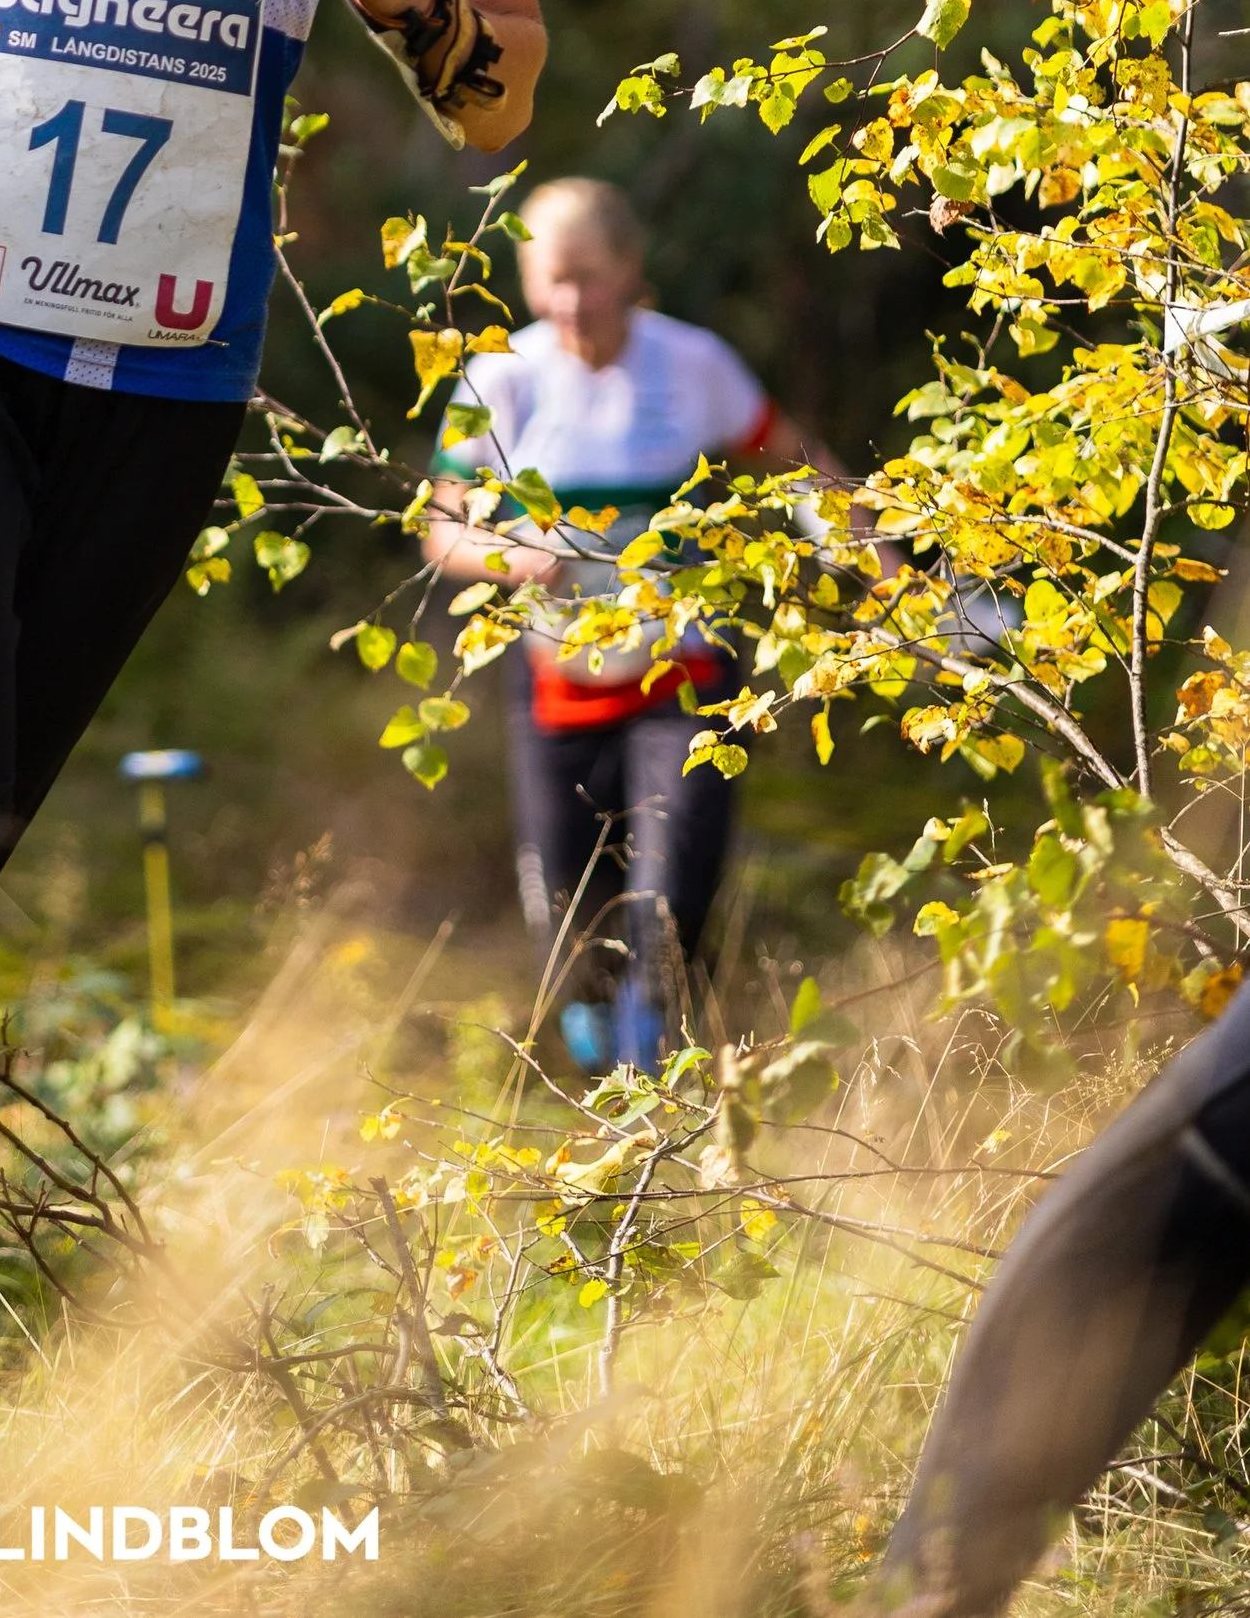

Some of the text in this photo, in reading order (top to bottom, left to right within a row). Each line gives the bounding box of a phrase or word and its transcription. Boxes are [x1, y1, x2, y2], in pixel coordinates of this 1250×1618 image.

[8, 30, 37, 49] SM
[188, 61, 227, 83] 2025
[28, 98, 174, 245] 17
[21, 255, 141, 308] Ullmax
